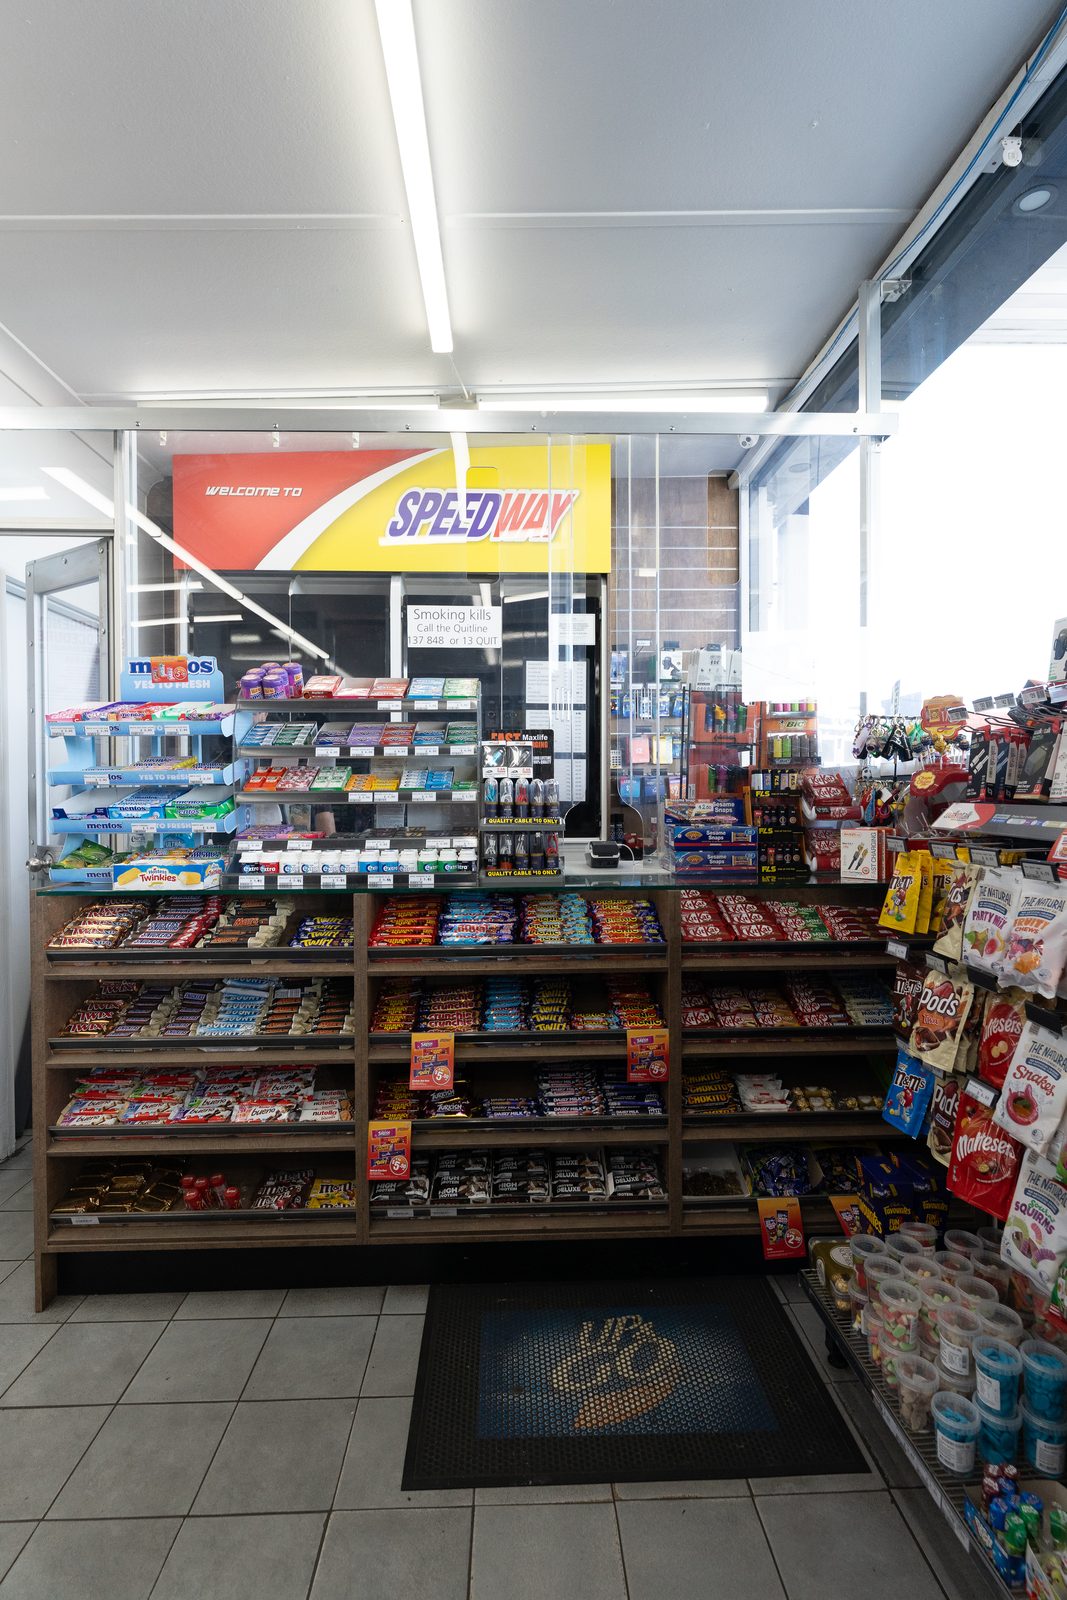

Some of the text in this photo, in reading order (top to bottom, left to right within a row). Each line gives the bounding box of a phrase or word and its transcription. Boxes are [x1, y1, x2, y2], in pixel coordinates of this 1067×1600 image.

[284, 487, 303, 496] TO
[388, 489, 579, 539] SPEEDWAY
[414, 608, 491, 623] Smoking kills
[417, 624, 488, 633] Call the Quitline
[408, 636, 425, 645] 137
[426, 636, 444, 645] 848
[463, 636, 473, 645] 13
[474, 636, 498, 646] QUIT
[129, 661, 213, 674] mos
[176, 680, 210, 689] FRESH
[816, 785, 841, 796] KitKat
[140, 874, 177, 883] Twinkies
[987, 887, 1012, 906] NATURAL
[1022, 896, 1066, 912] THE NATURAL
[683, 912, 712, 924] KitKat
[734, 913, 763, 924] KitKat
[972, 911, 994, 923] PARTY
[689, 924, 720, 937] KitKat
[742, 924, 774, 937] KitKat
[920, 988, 959, 1017] Pods
[428, 1011, 473, 1020] crunchie
[428, 1018, 473, 1027] crunchie
[1028, 1041, 1043, 1055] THE
[1012, 1064, 1056, 1097] Snakes
[688, 1095, 727, 1104] CHOKITO
[251, 1108, 276, 1117] bueno
[438, 1104, 462, 1112] TURKISH
[956, 1132, 1017, 1162] Maltesers
[615, 1176, 640, 1184] DELUXE
[1027, 1170, 1042, 1186] THE
[1014, 1201, 1055, 1235] SQUIRMS
